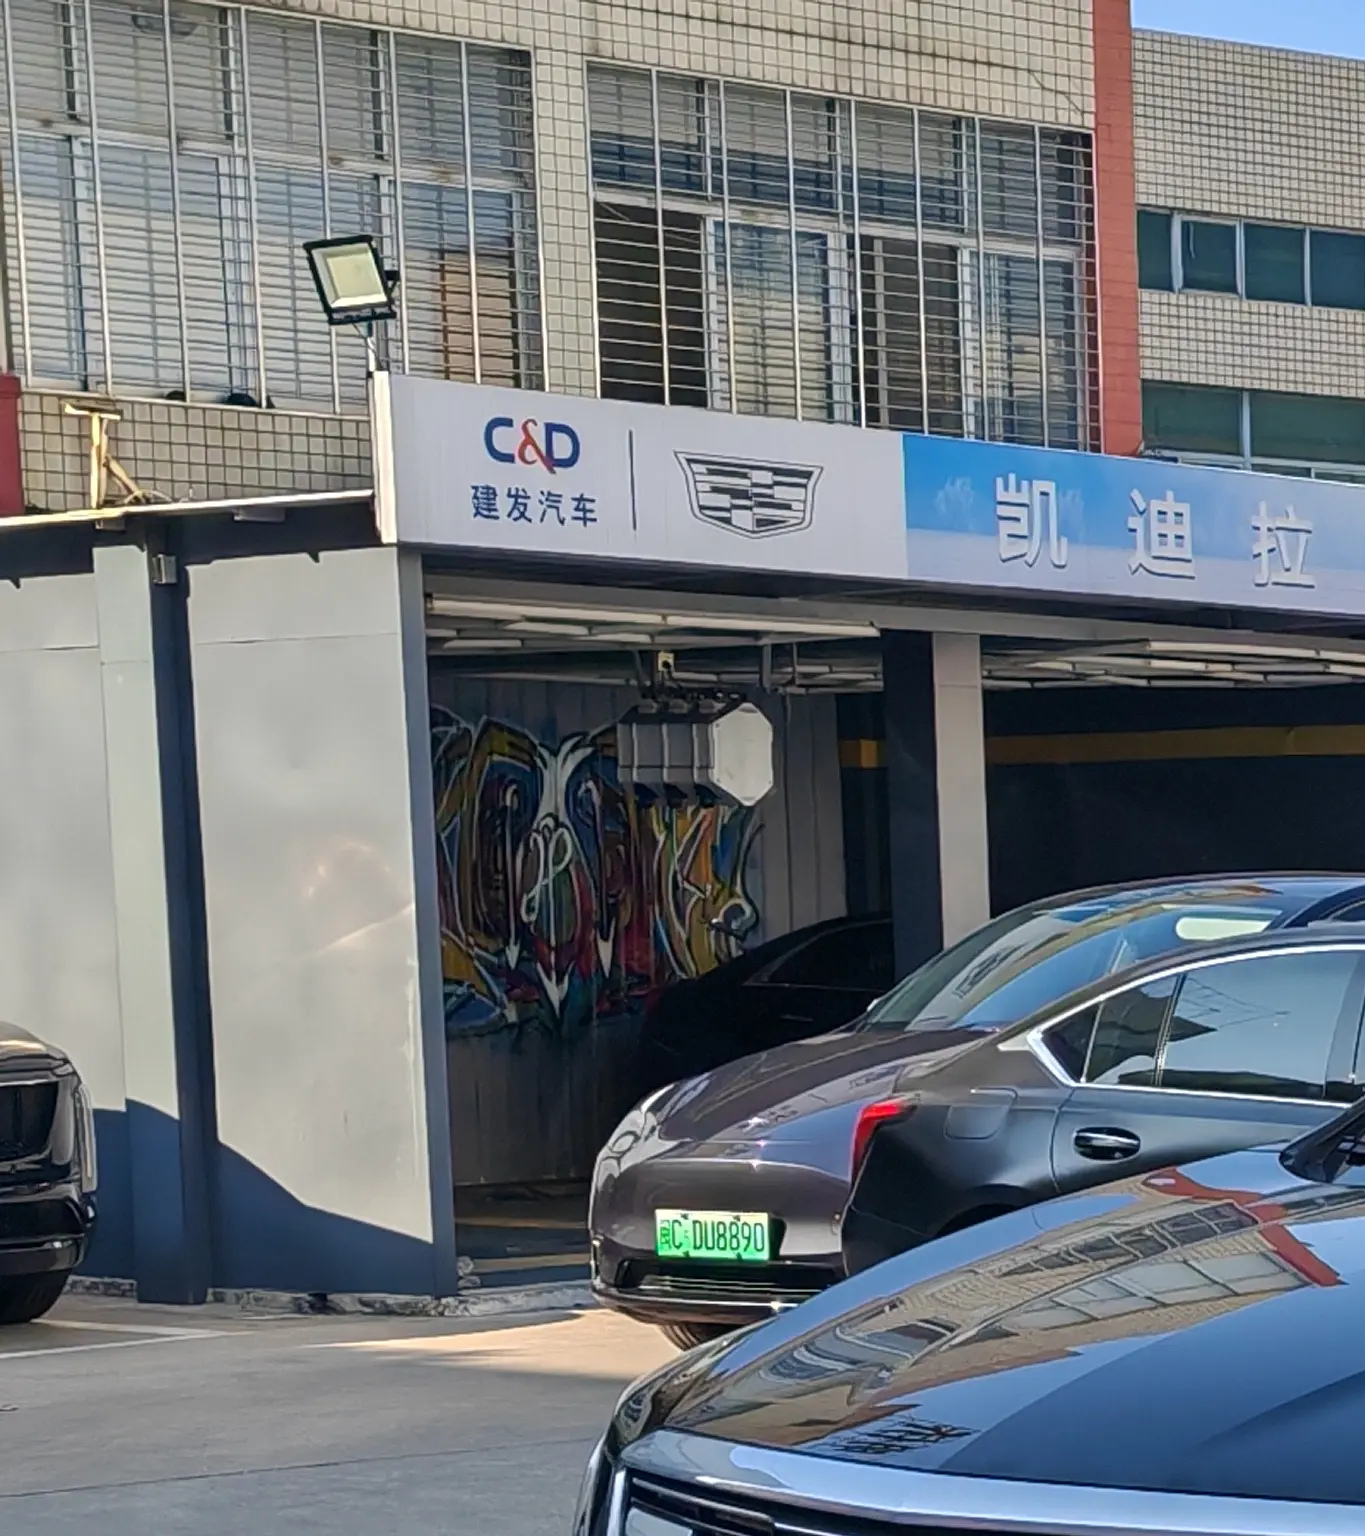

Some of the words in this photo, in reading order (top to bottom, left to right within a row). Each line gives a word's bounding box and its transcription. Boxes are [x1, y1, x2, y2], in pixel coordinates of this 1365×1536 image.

[484, 416, 580, 475] C&D
[470, 484, 598, 528] 建发汽车
